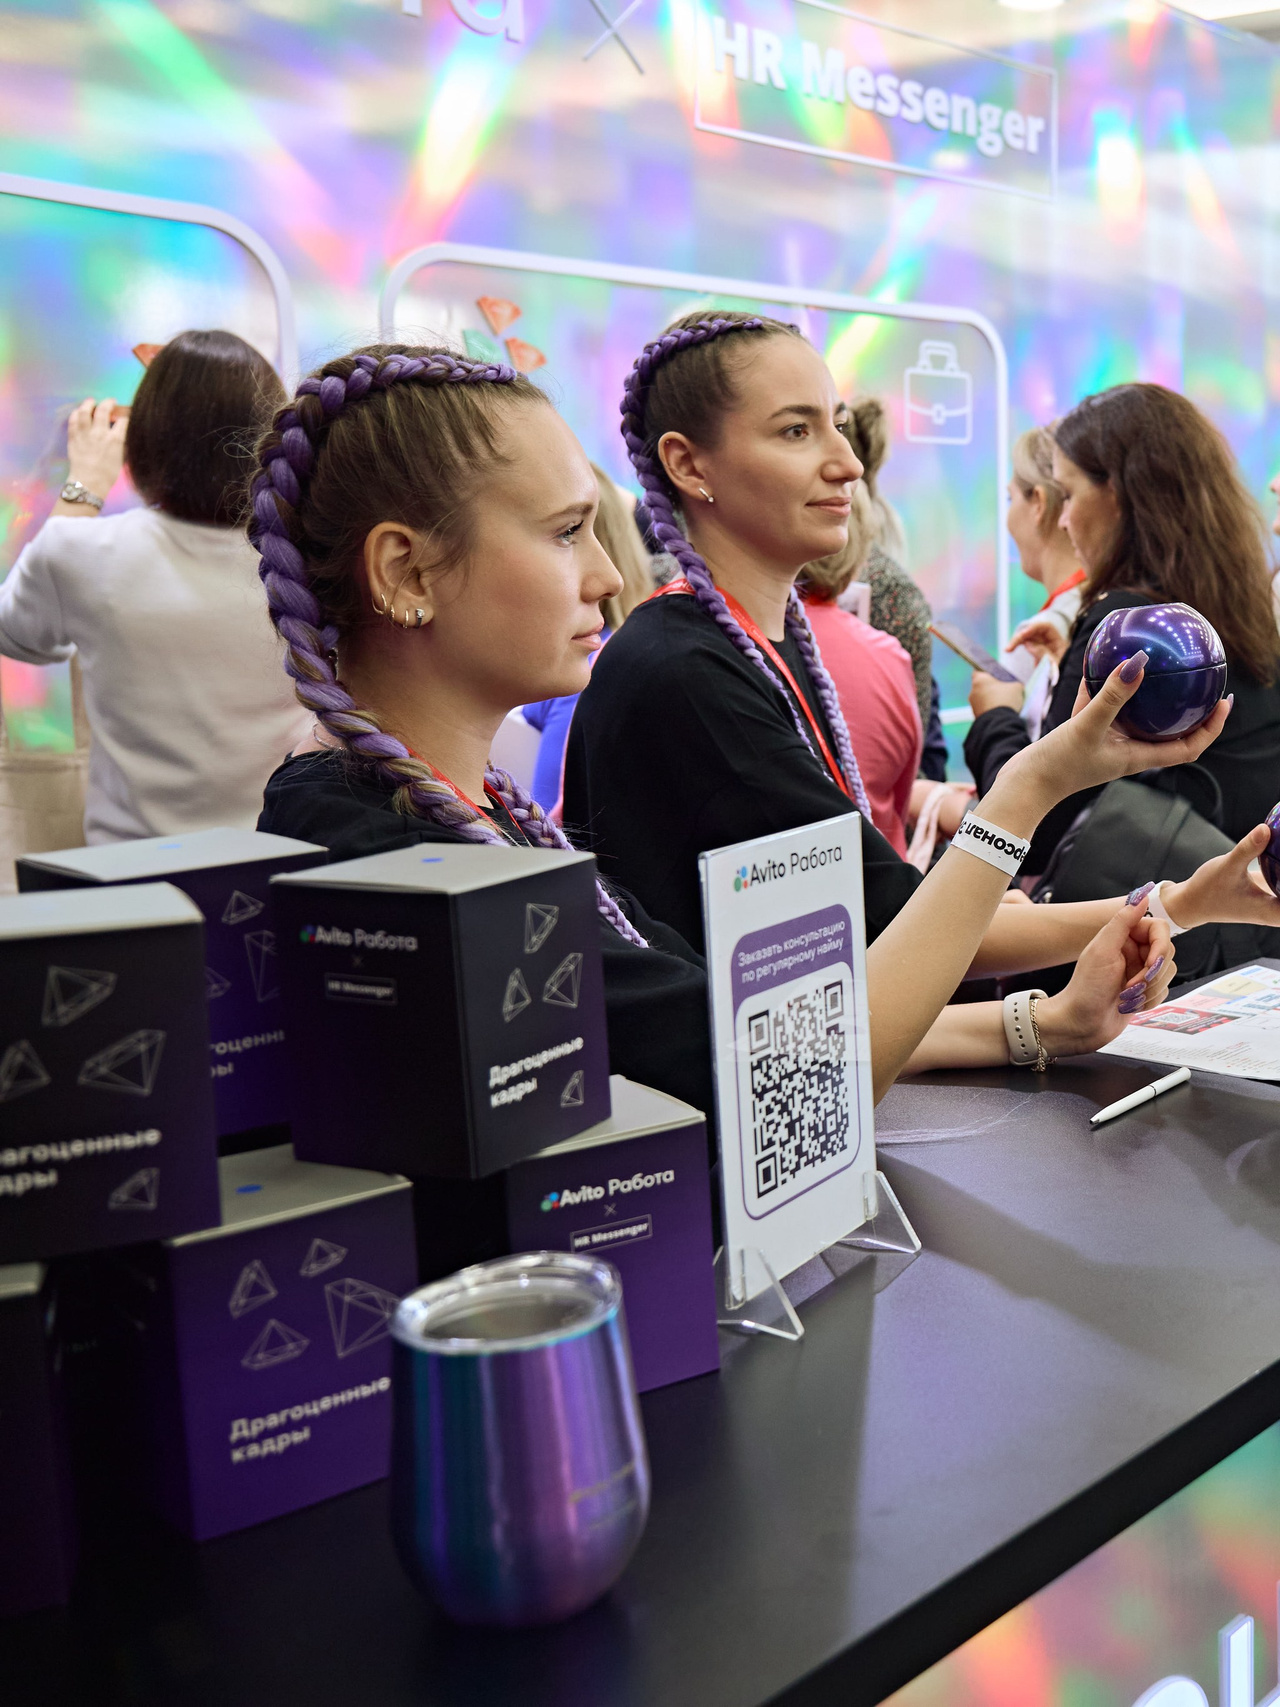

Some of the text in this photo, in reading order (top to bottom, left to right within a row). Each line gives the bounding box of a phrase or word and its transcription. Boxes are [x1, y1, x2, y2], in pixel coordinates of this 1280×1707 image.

[711, 14, 1047, 158] HR Messenger
[749, 846, 843, 887] Avito Работа
[315, 925, 419, 951] Avito Работа
[737, 921, 846, 967] Заказать консультацию
[741, 938, 844, 983] по регулярному найму
[489, 1036, 584, 1089] Драгоценные
[490, 1077, 538, 1108] кадры
[0, 1128, 162, 1167] агоценные
[559, 1169, 675, 1208] Avito Работа
[574, 1222, 650, 1248] HR Messenger
[229, 1376, 391, 1444] Драгоценные
[231, 1426, 311, 1464] кадры
